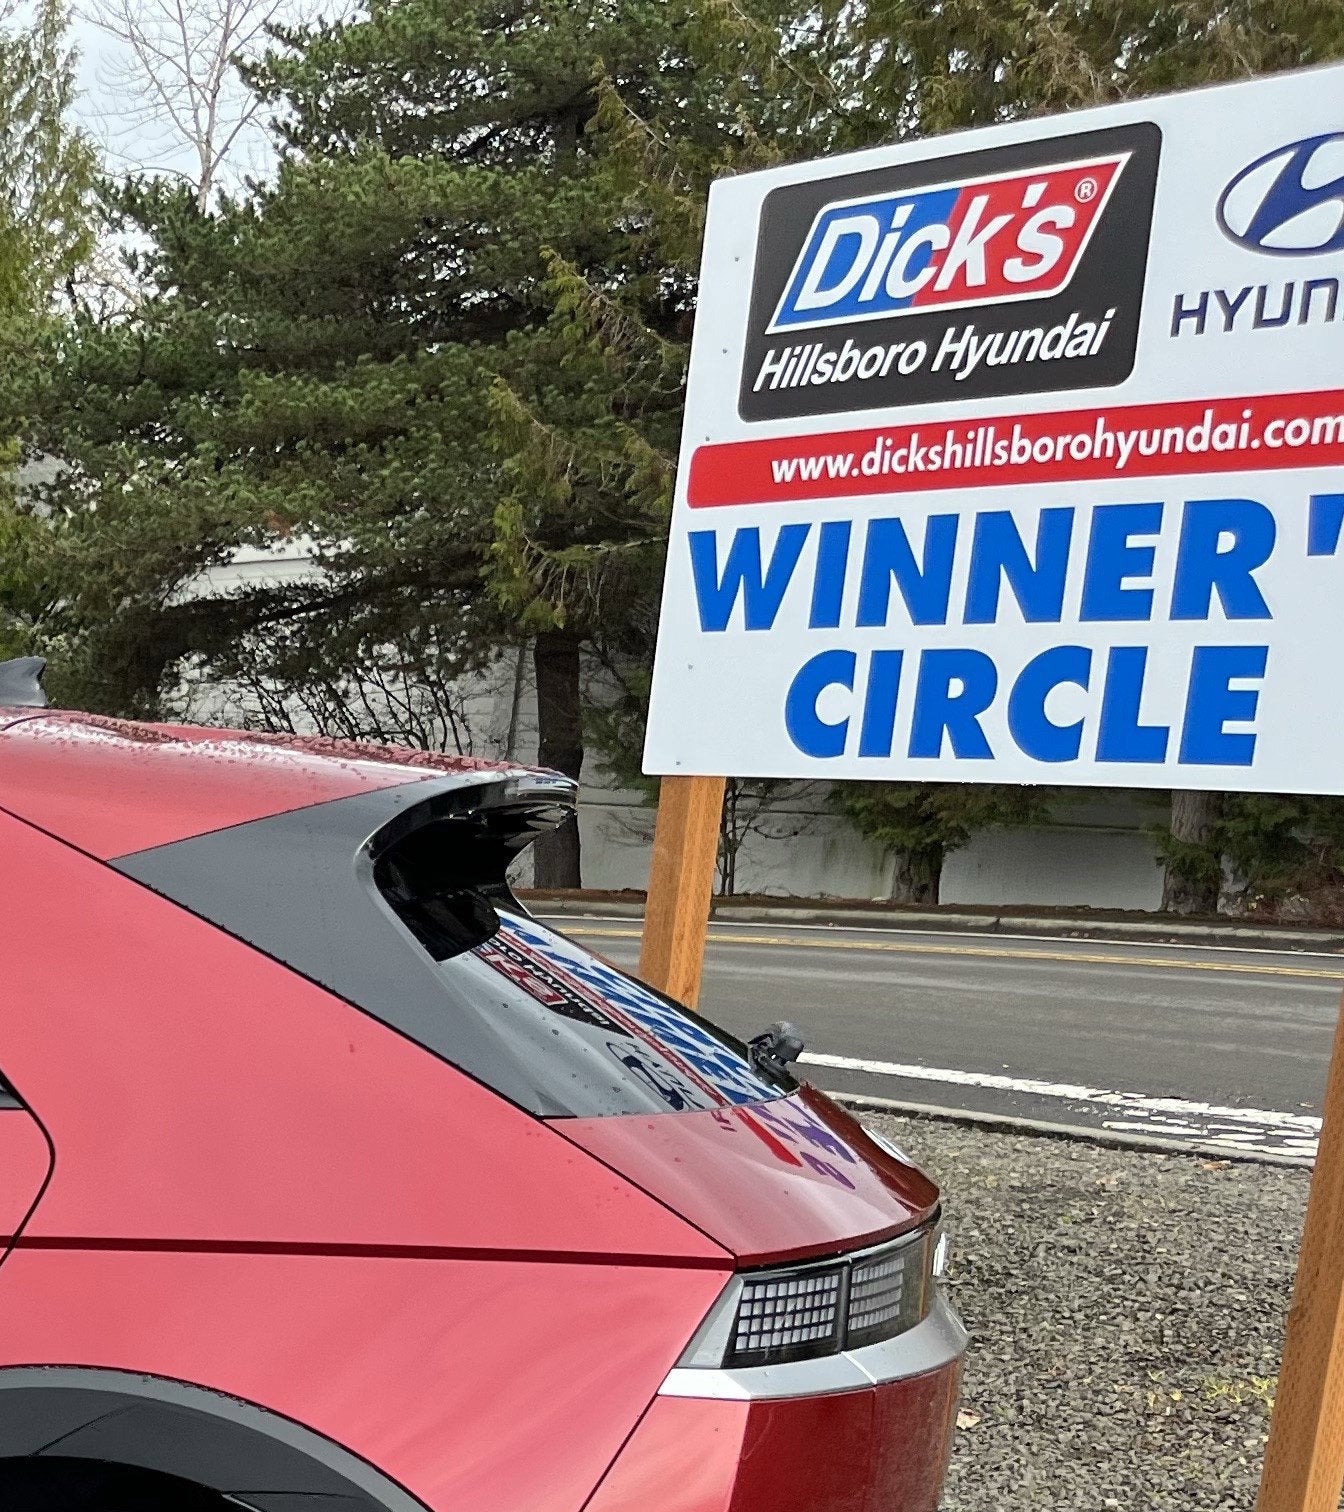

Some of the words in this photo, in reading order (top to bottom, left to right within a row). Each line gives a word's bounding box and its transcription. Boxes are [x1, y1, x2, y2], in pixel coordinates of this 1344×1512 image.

[810, 183, 1079, 309] Dick's
[752, 340, 925, 393] Hillsboro
[931, 308, 1115, 382] Hyundai
[1170, 278, 1344, 338] HYUN
[771, 408, 1344, 484] www.dickshillsborohyundai.com
[785, 645, 1269, 767] CIRCLE
